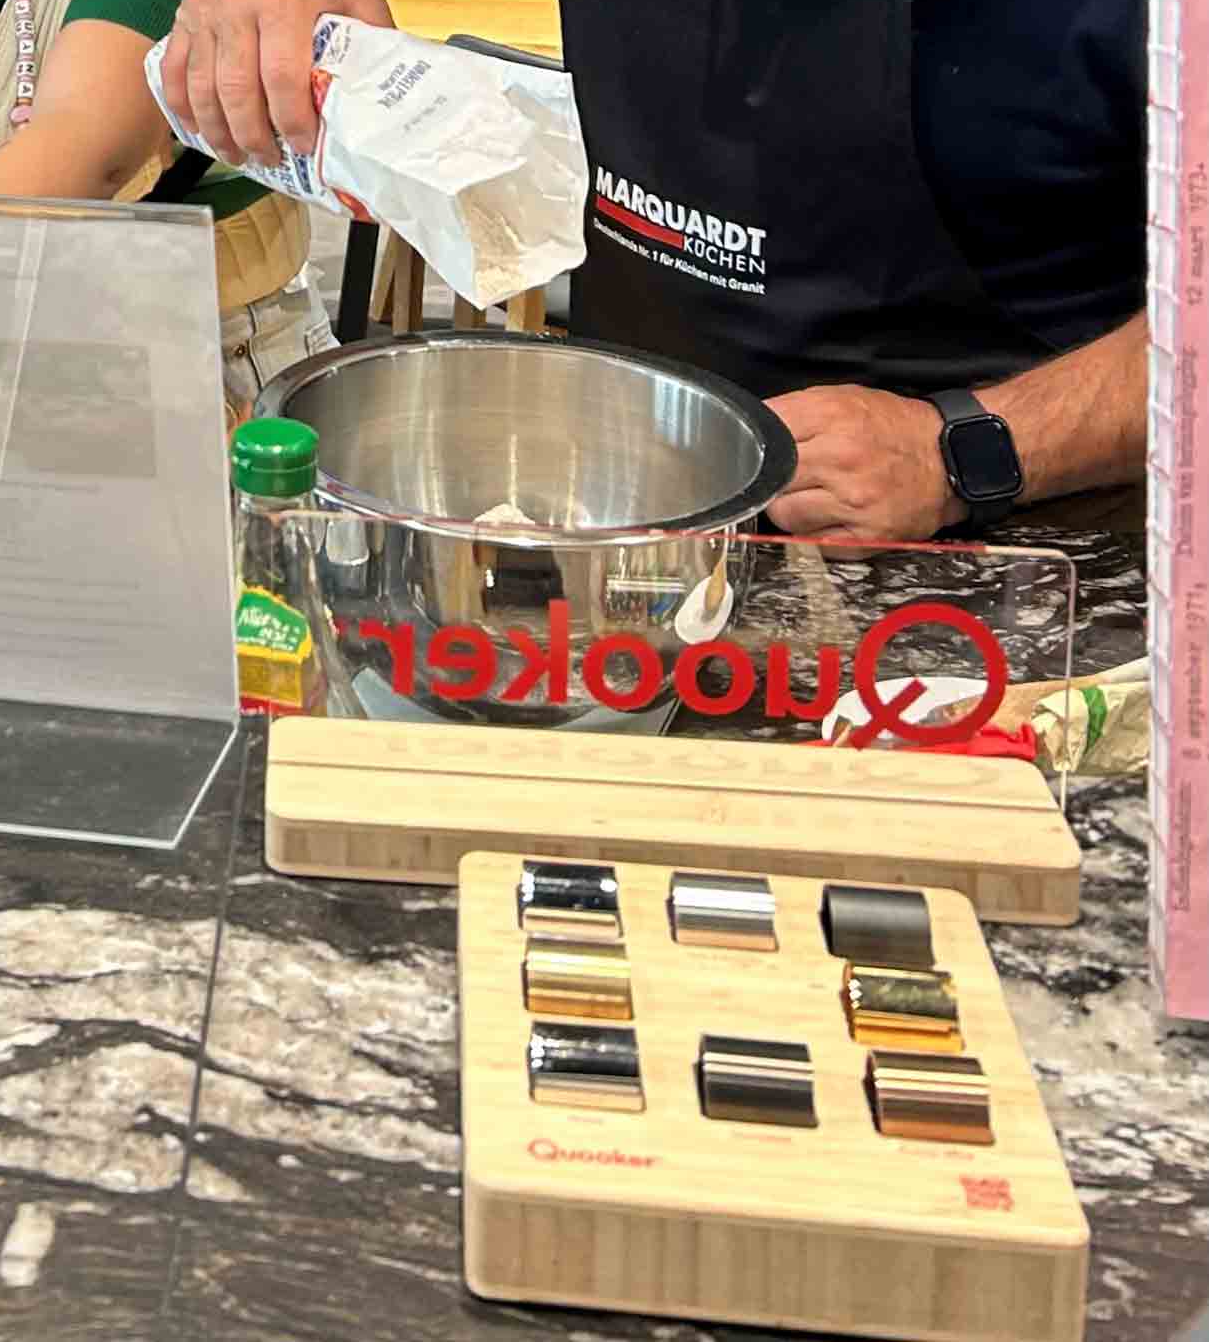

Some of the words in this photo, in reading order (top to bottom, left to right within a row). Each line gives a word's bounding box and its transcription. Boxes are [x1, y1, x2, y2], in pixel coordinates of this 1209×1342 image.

[595, 166, 767, 257] MARQUARDT
[683, 234, 766, 275] KÜCHEN
[709, 274, 728, 289] mit
[728, 278, 766, 296] Granit
[527, 1137, 656, 1169] Quooker
